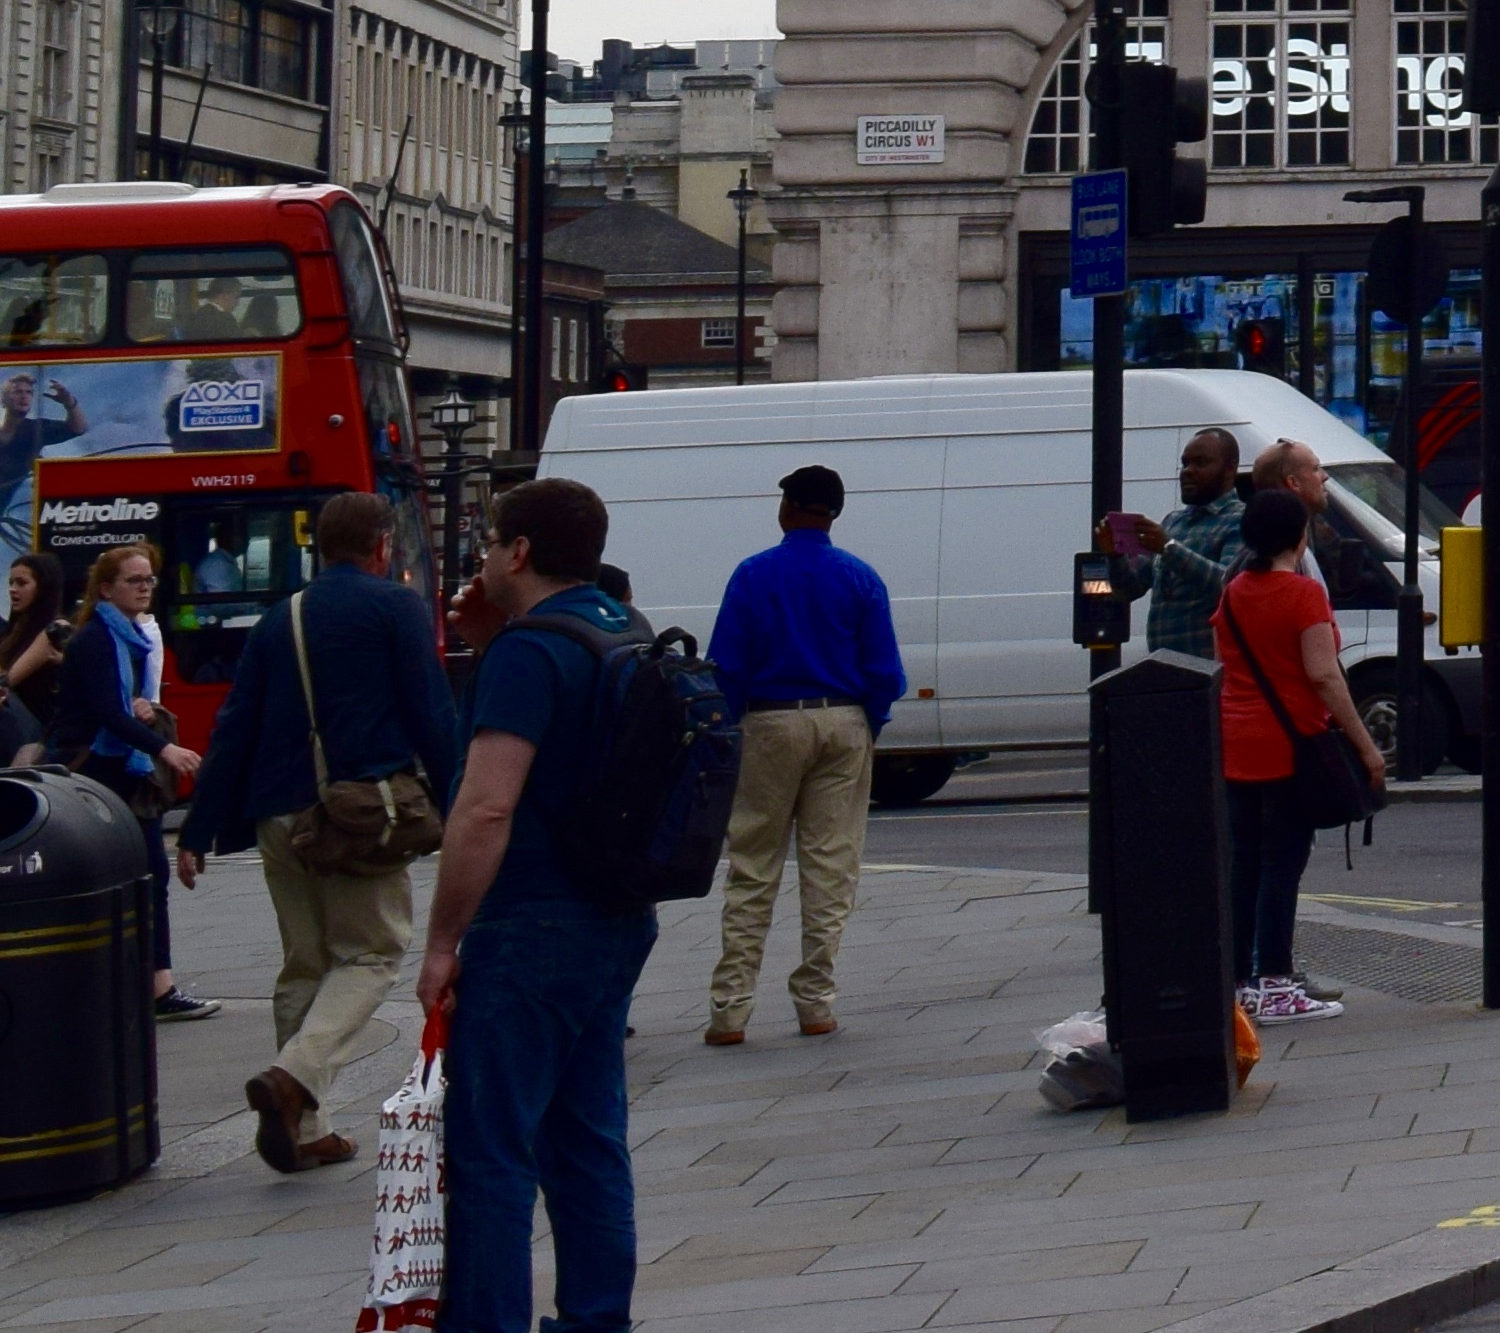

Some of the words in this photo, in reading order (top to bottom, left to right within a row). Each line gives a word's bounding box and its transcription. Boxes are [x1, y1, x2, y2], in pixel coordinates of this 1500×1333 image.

[1267, 37, 1472, 130] Stng
[865, 120, 936, 133] PICCADILLY
[865, 135, 912, 148] CIRCUS
[916, 135, 935, 147] W1
[190, 414, 254, 426] EXCLUSIVE
[192, 473, 256, 487] VWH2119
[40, 497, 161, 525] Metroline
[1082, 580, 1113, 594] WA
